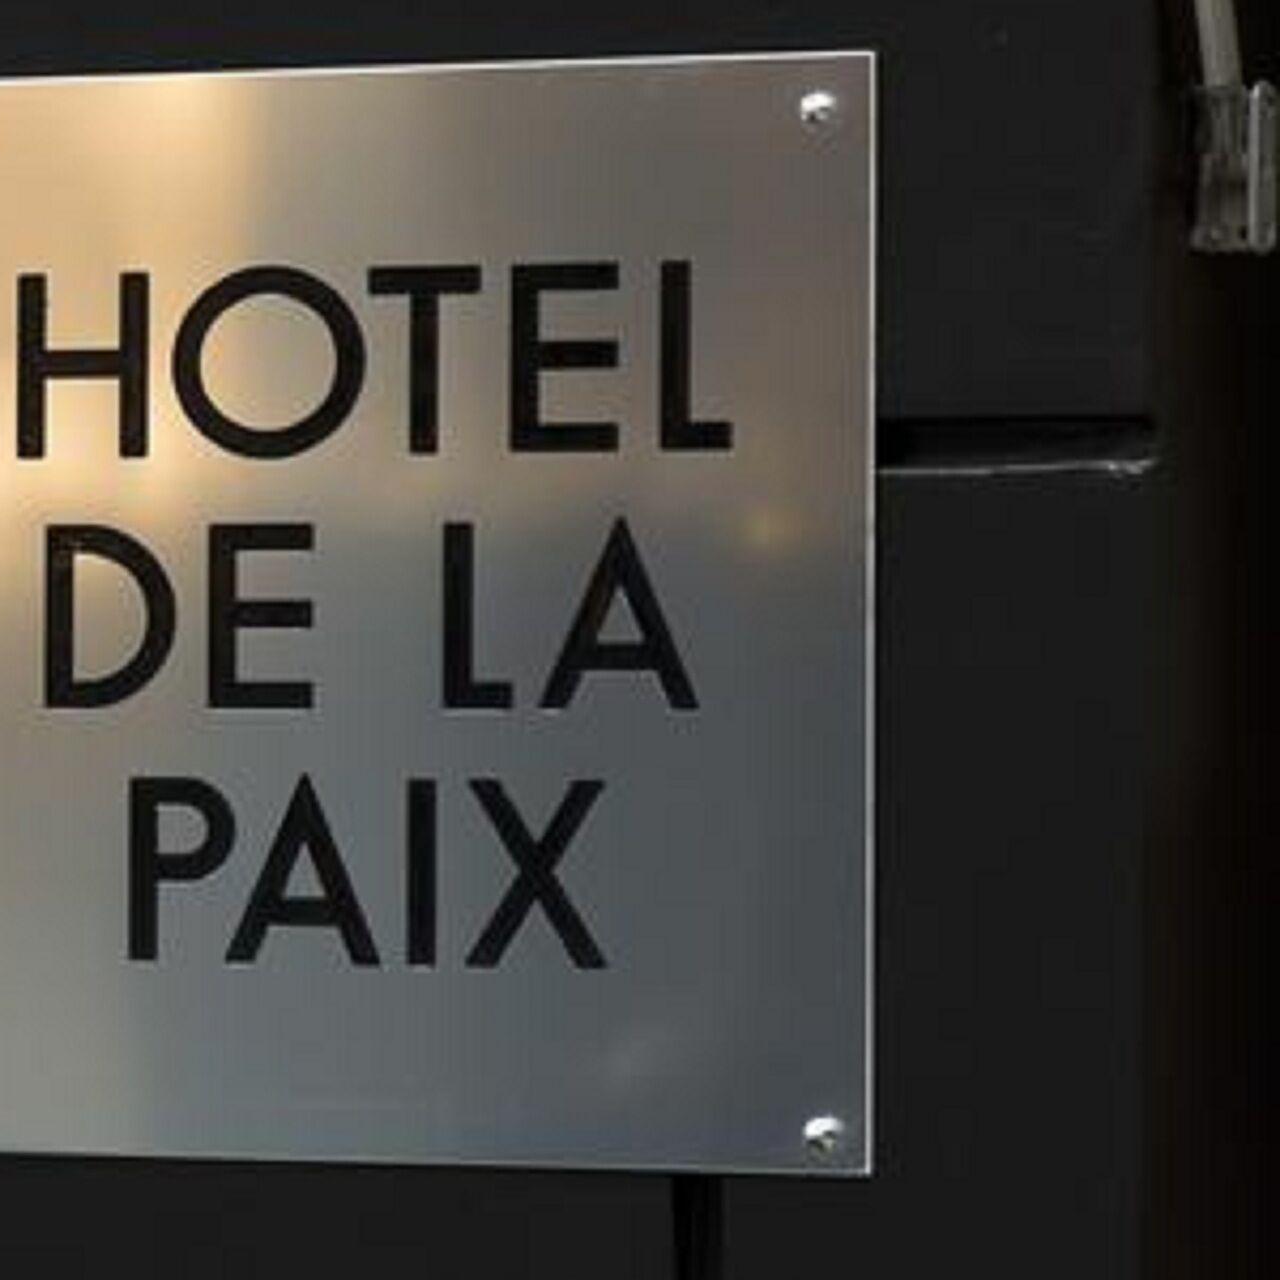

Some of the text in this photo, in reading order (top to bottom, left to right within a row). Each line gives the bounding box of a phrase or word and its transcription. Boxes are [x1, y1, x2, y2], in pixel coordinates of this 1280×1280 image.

[17, 261, 733, 459] HOTEL
[43, 516, 700, 713] DE LA
[128, 773, 611, 971] PAIX
